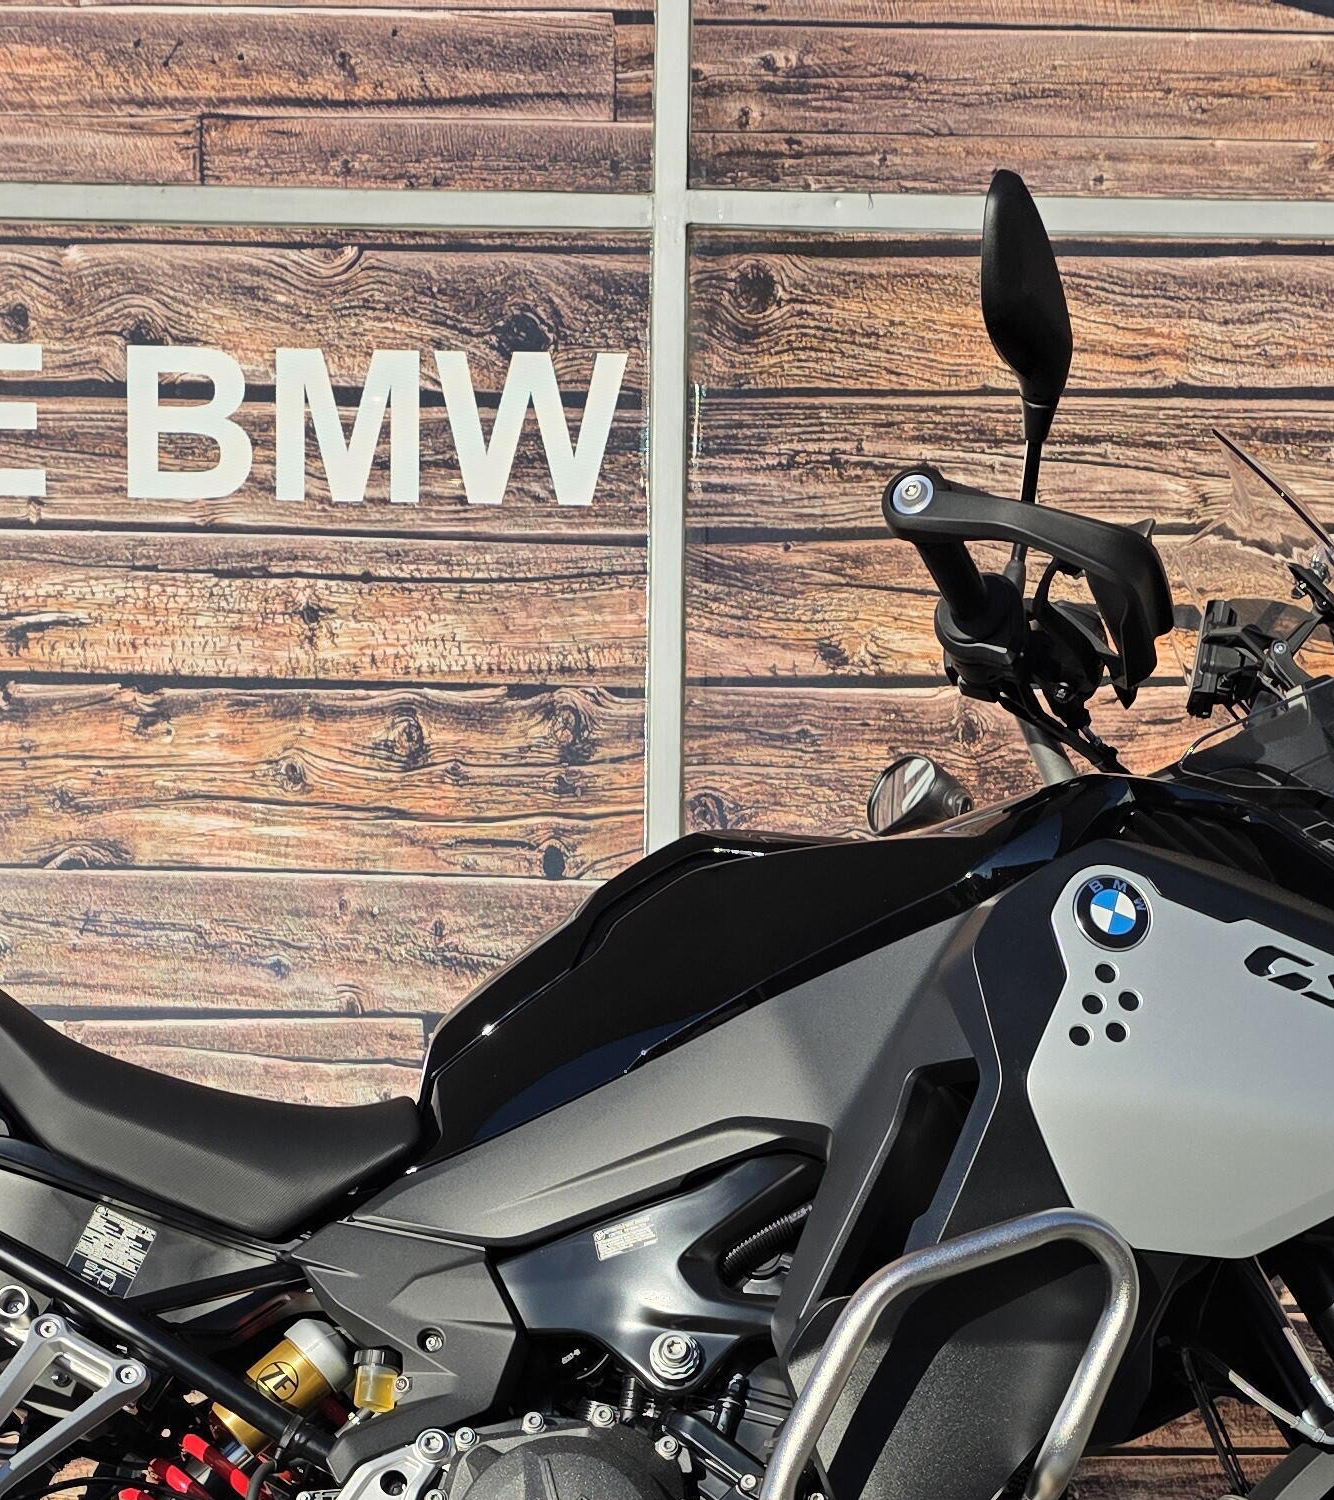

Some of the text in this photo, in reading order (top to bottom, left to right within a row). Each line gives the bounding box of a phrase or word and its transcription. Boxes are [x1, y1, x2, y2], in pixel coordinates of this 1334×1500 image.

[126, 343, 629, 507] BMW
[1087, 878, 1147, 912] BMW
[257, 1362, 299, 1402] ZF
